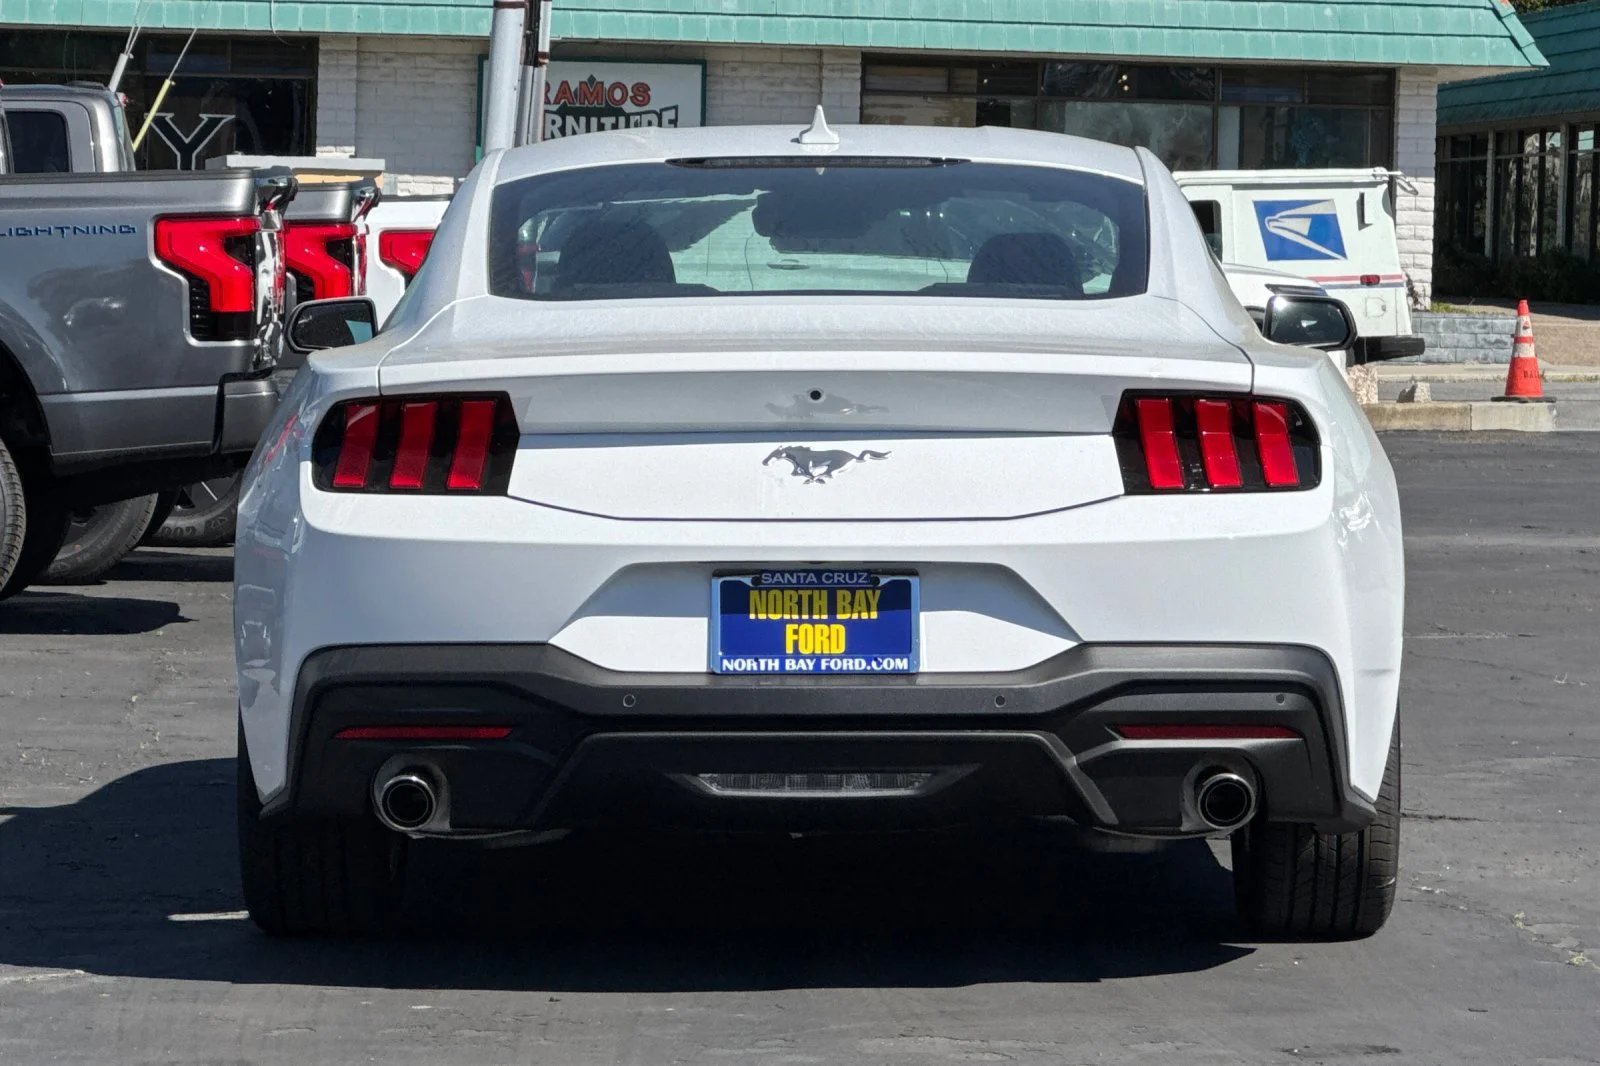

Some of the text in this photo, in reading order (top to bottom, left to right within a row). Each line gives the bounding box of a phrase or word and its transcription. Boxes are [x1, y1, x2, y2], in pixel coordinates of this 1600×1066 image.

[761, 572, 869, 584] SANTA CRUZ
[749, 589, 881, 620] NORTH BAY
[785, 623, 846, 654] FORD
[722, 657, 909, 671] NORTH BAY FORD.COM
